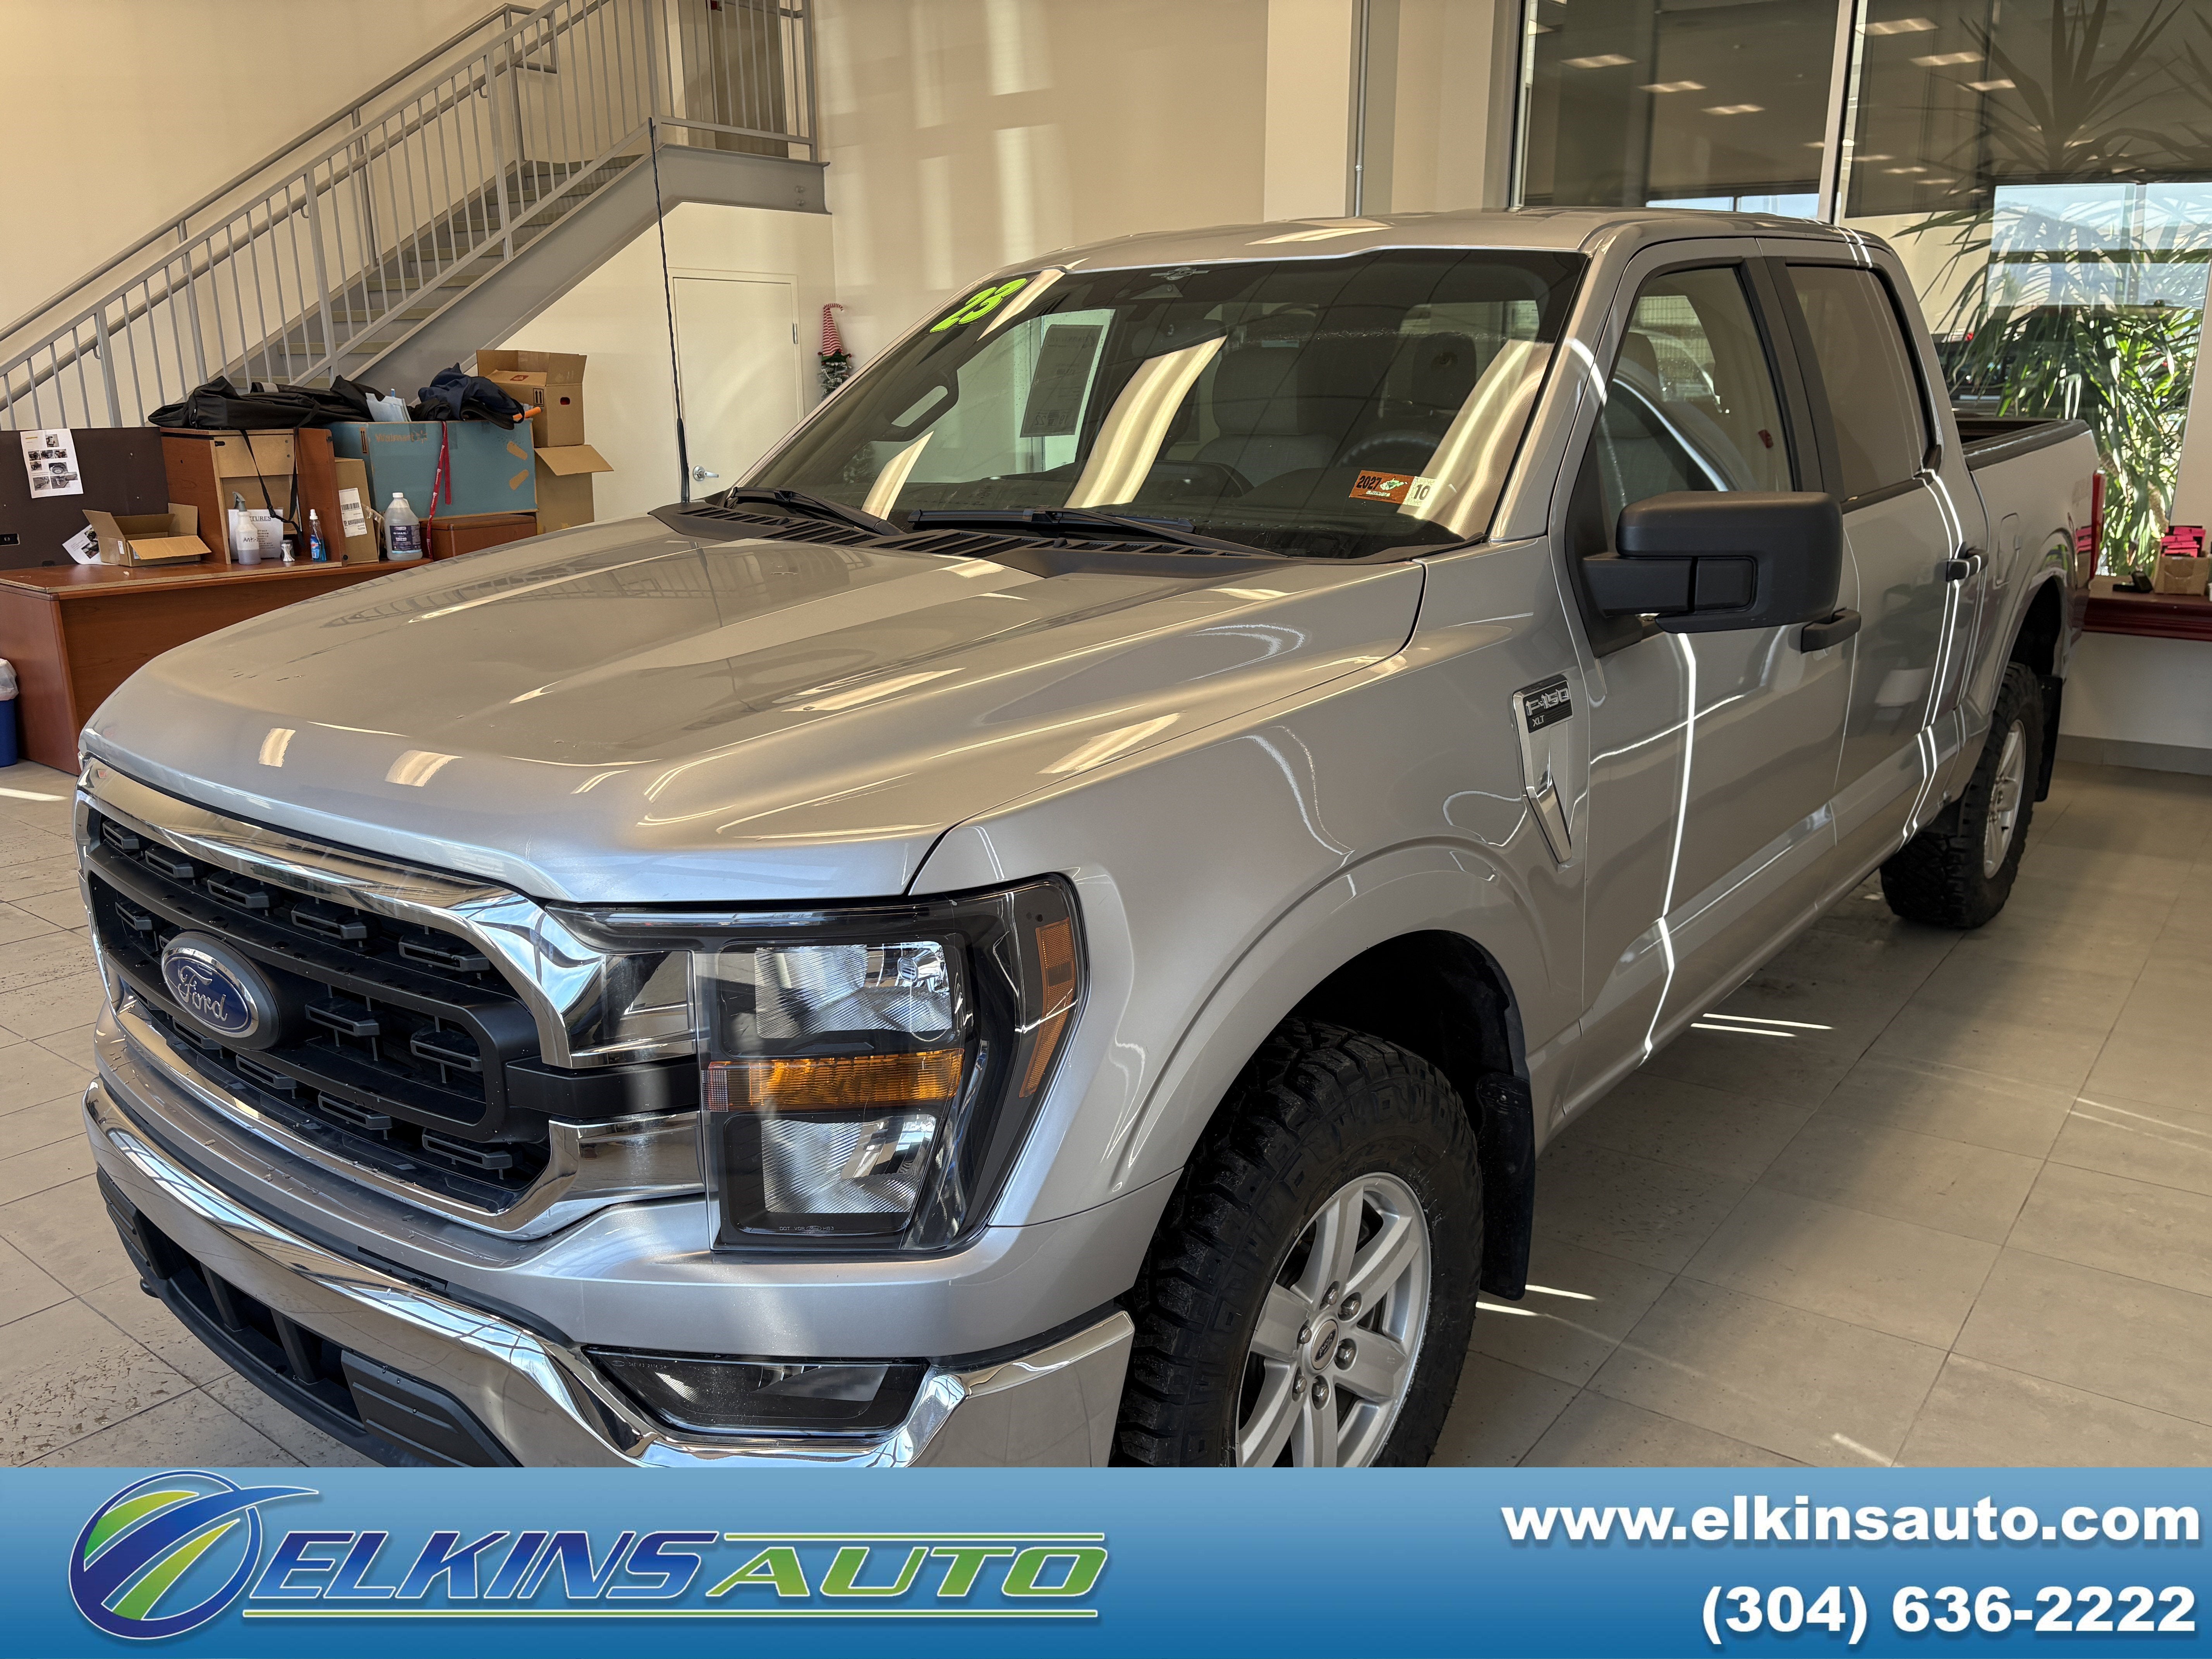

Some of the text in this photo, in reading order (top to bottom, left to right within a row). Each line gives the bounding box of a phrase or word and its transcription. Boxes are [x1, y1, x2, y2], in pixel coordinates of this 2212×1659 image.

[930, 278, 1028, 333] 23
[1356, 476, 1382, 490] 2027
[1413, 484, 1431, 500] 10
[1526, 688, 1570, 716] F-150
[1532, 715, 1544, 727] XLT
[178, 965, 228, 1021] Ford
[1319, 1333, 1333, 1357] Ford
